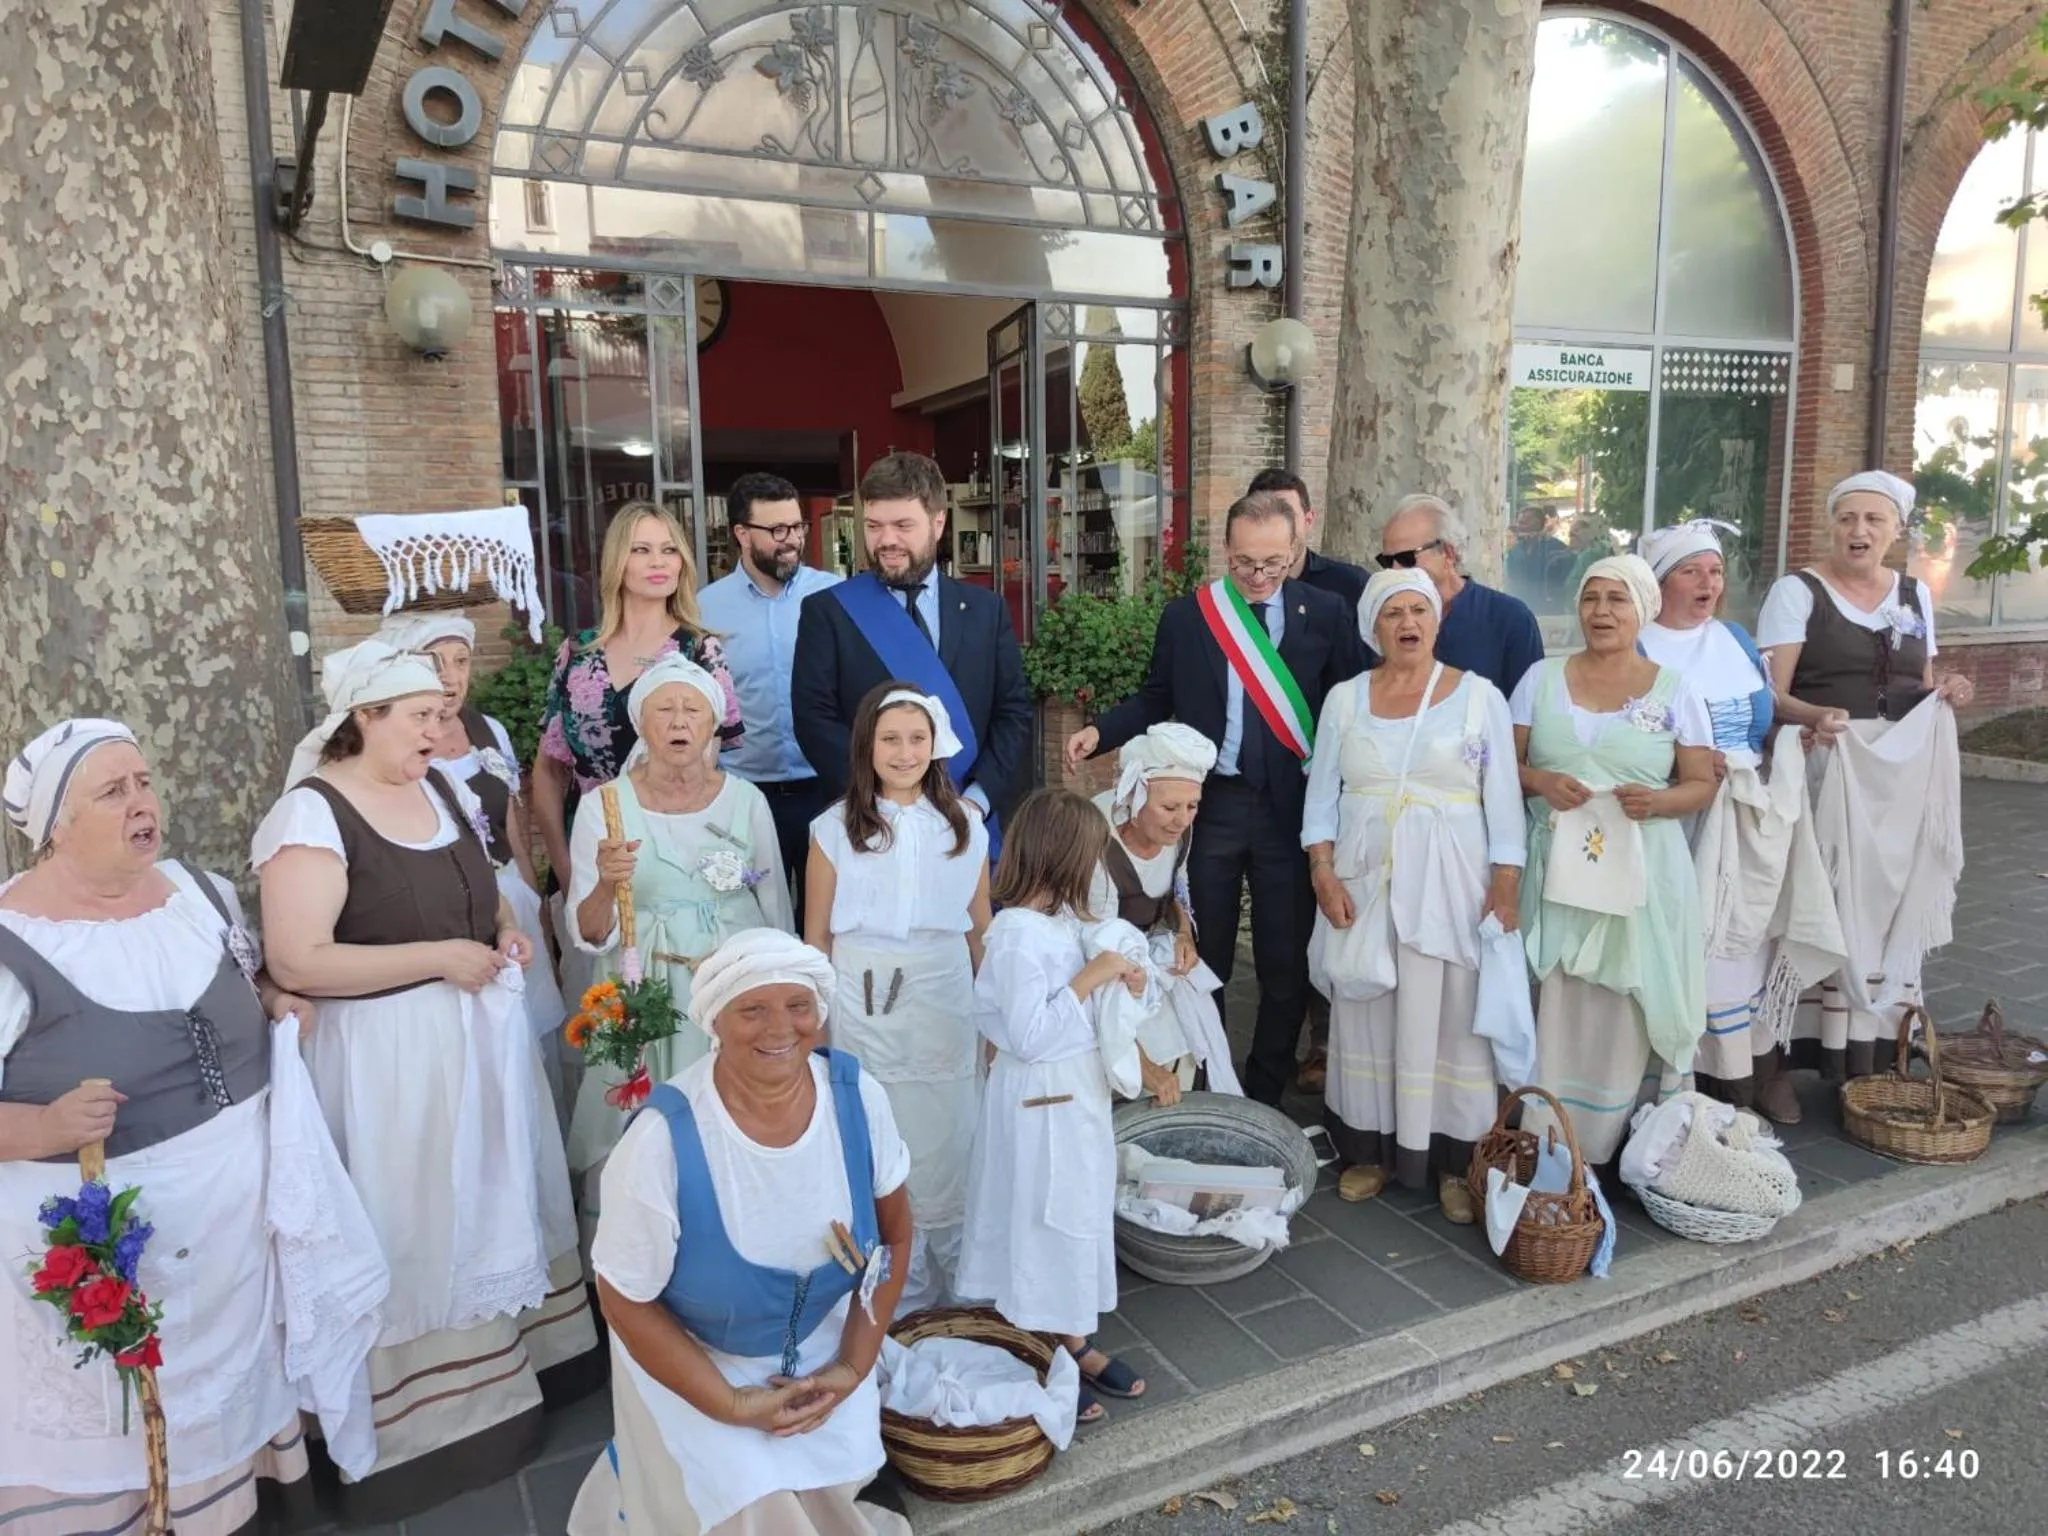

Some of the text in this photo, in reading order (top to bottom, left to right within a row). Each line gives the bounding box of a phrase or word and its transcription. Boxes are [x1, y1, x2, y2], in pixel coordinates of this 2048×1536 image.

[393, 0, 526, 229] HOT
[1203, 101, 1284, 288] BAR
[1527, 368, 1633, 385] ASSICURAZIONE
[1559, 352, 1605, 366] BANCA
